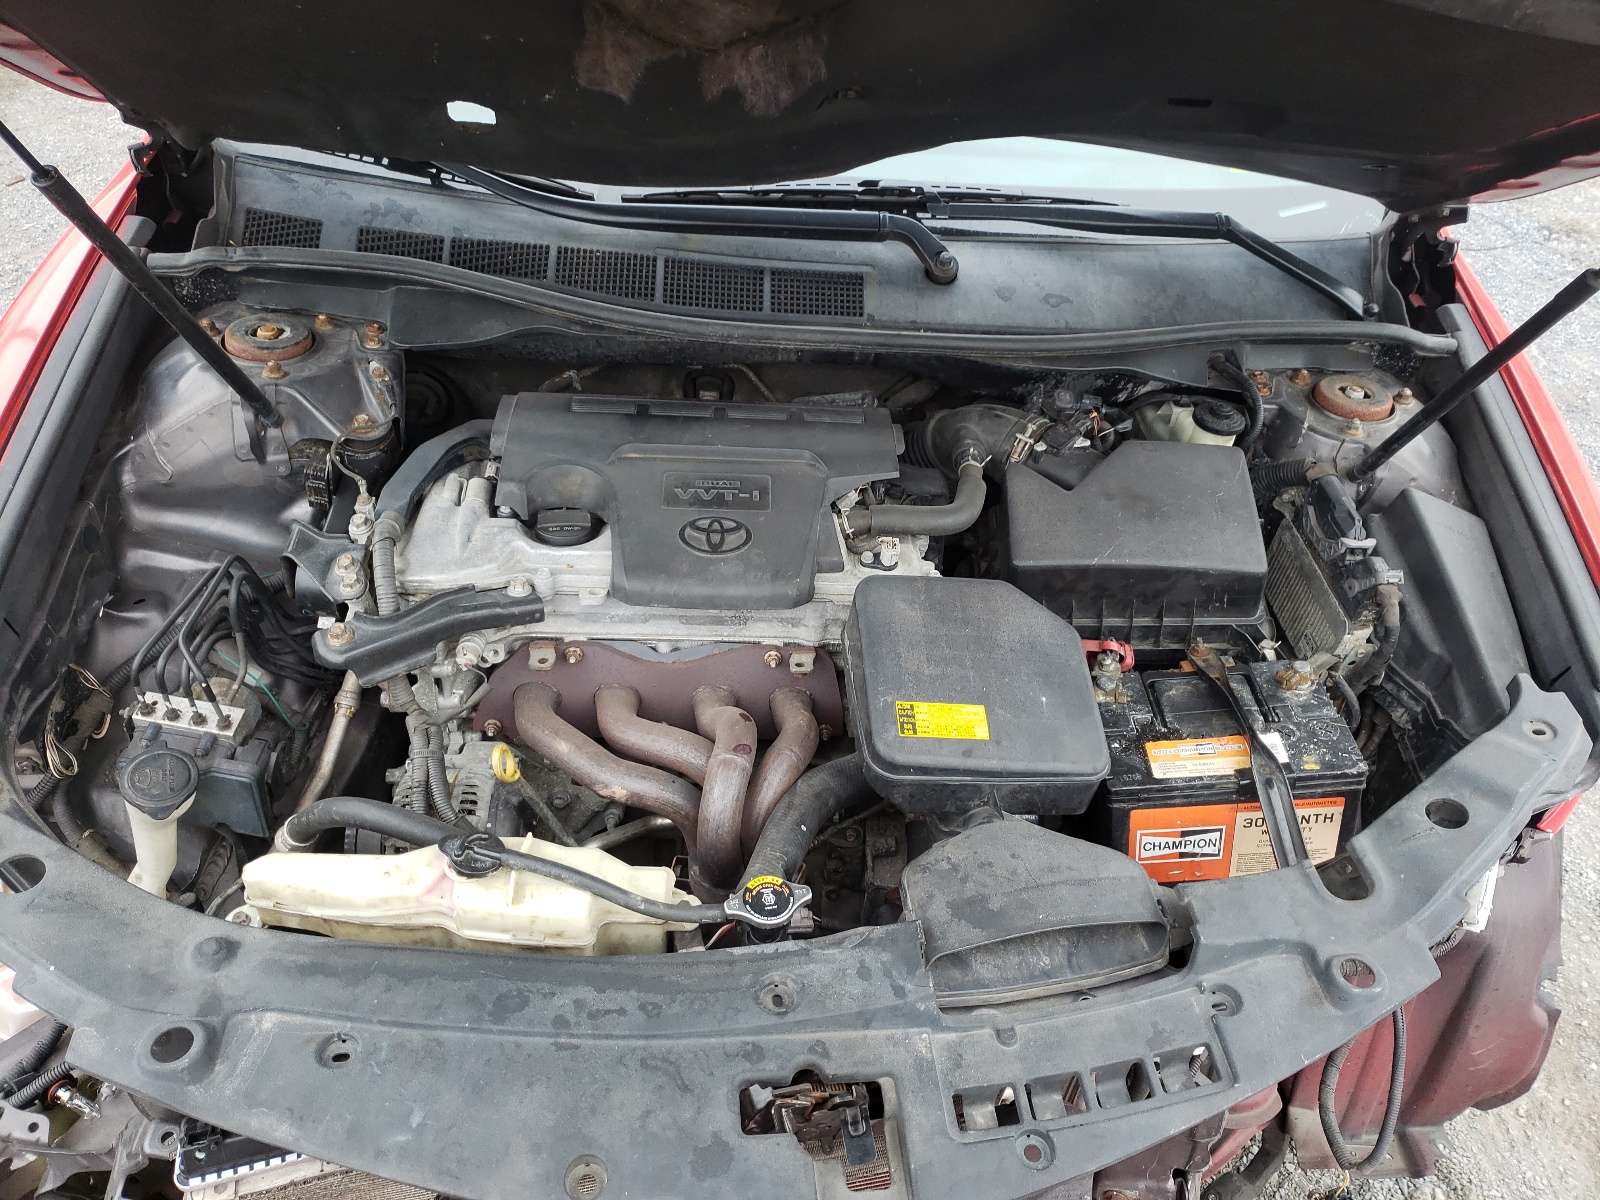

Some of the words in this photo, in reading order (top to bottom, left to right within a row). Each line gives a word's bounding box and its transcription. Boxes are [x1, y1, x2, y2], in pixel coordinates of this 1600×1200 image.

[1242, 816, 1265, 829] 30
[1297, 812, 1335, 825] NTH
[1142, 838, 1218, 852] CHAMPION
